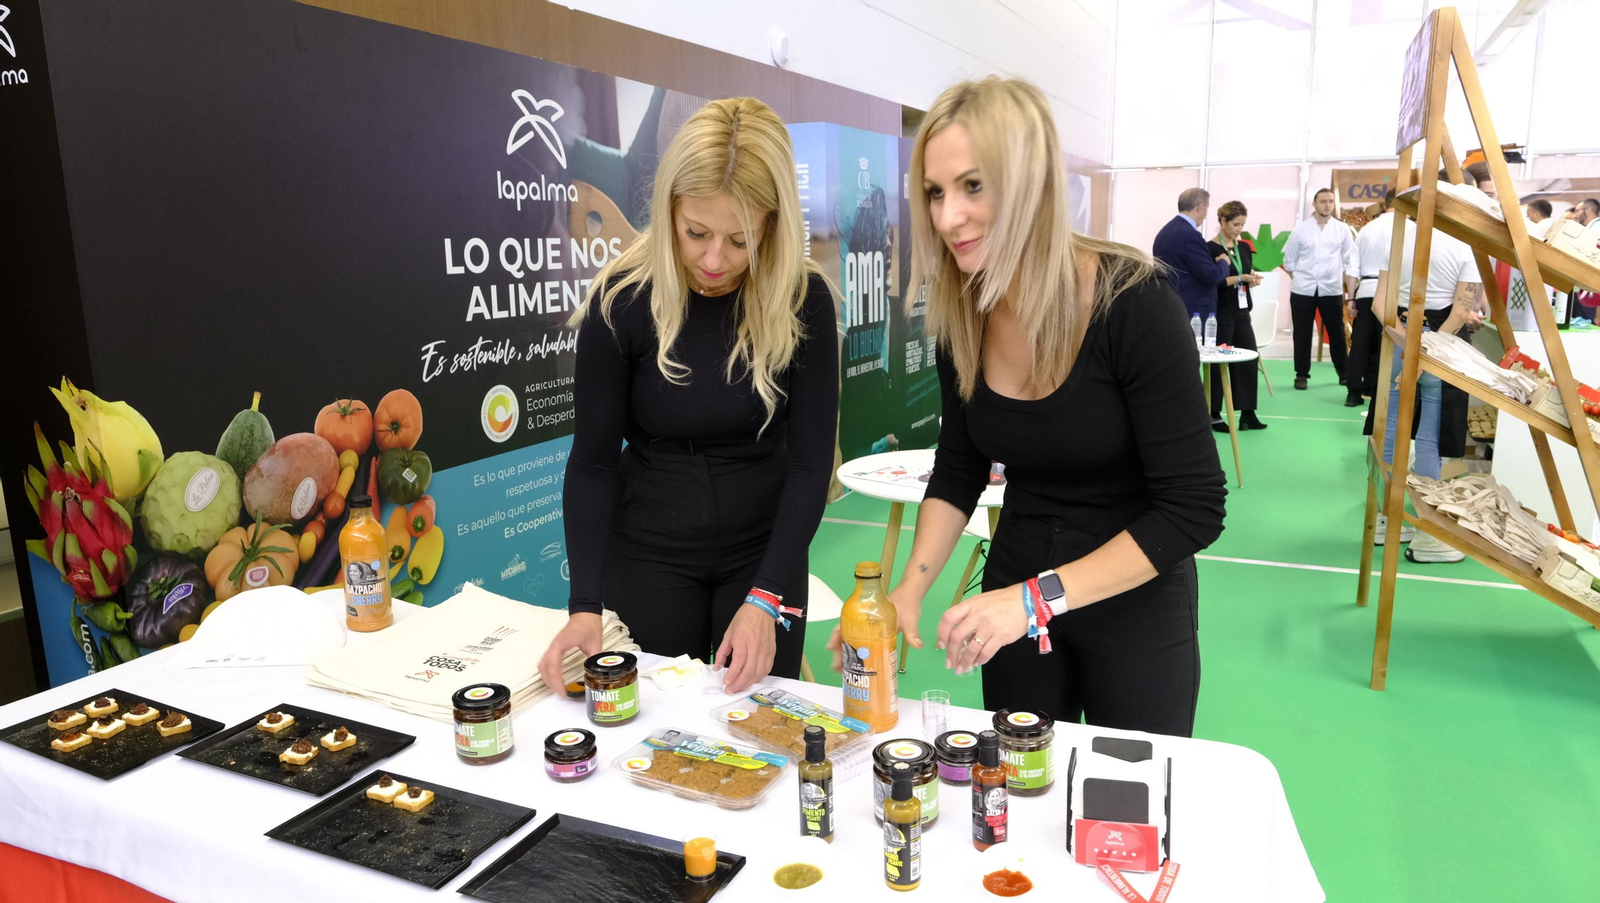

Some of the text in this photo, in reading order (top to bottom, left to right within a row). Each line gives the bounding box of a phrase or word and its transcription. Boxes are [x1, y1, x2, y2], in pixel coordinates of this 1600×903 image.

[0, 68, 29, 86] ma
[496, 170, 579, 211] lapalma
[443, 237, 622, 279] LO QUE NOS
[465, 279, 594, 322] ALIMENT
[845, 250, 886, 328] AMA
[421, 339, 448, 383] Es
[526, 330, 579, 362] saludabl
[850, 332, 859, 361] LO
[525, 376, 575, 394] AGRICULTURA
[526, 389, 574, 412] Economía
[527, 408, 575, 430] & Desperd
[474, 474, 486, 487] Es
[487, 470, 497, 481] lo
[498, 466, 516, 481] que
[517, 454, 554, 475] proviene
[555, 450, 566, 462] de
[505, 474, 553, 498] respetuosa
[553, 471, 560, 484] y
[457, 491, 563, 536] Es aquello que preserva
[504, 508, 564, 539] Es Cooperativ
[422, 659, 466, 672] TODOS
[429, 655, 462, 666] COSA
[591, 690, 620, 702] TOMATE
[595, 701, 616, 713] PERA
[998, 748, 1025, 766] OMATE
[1101, 863, 1131, 895] ALIMENTAC
